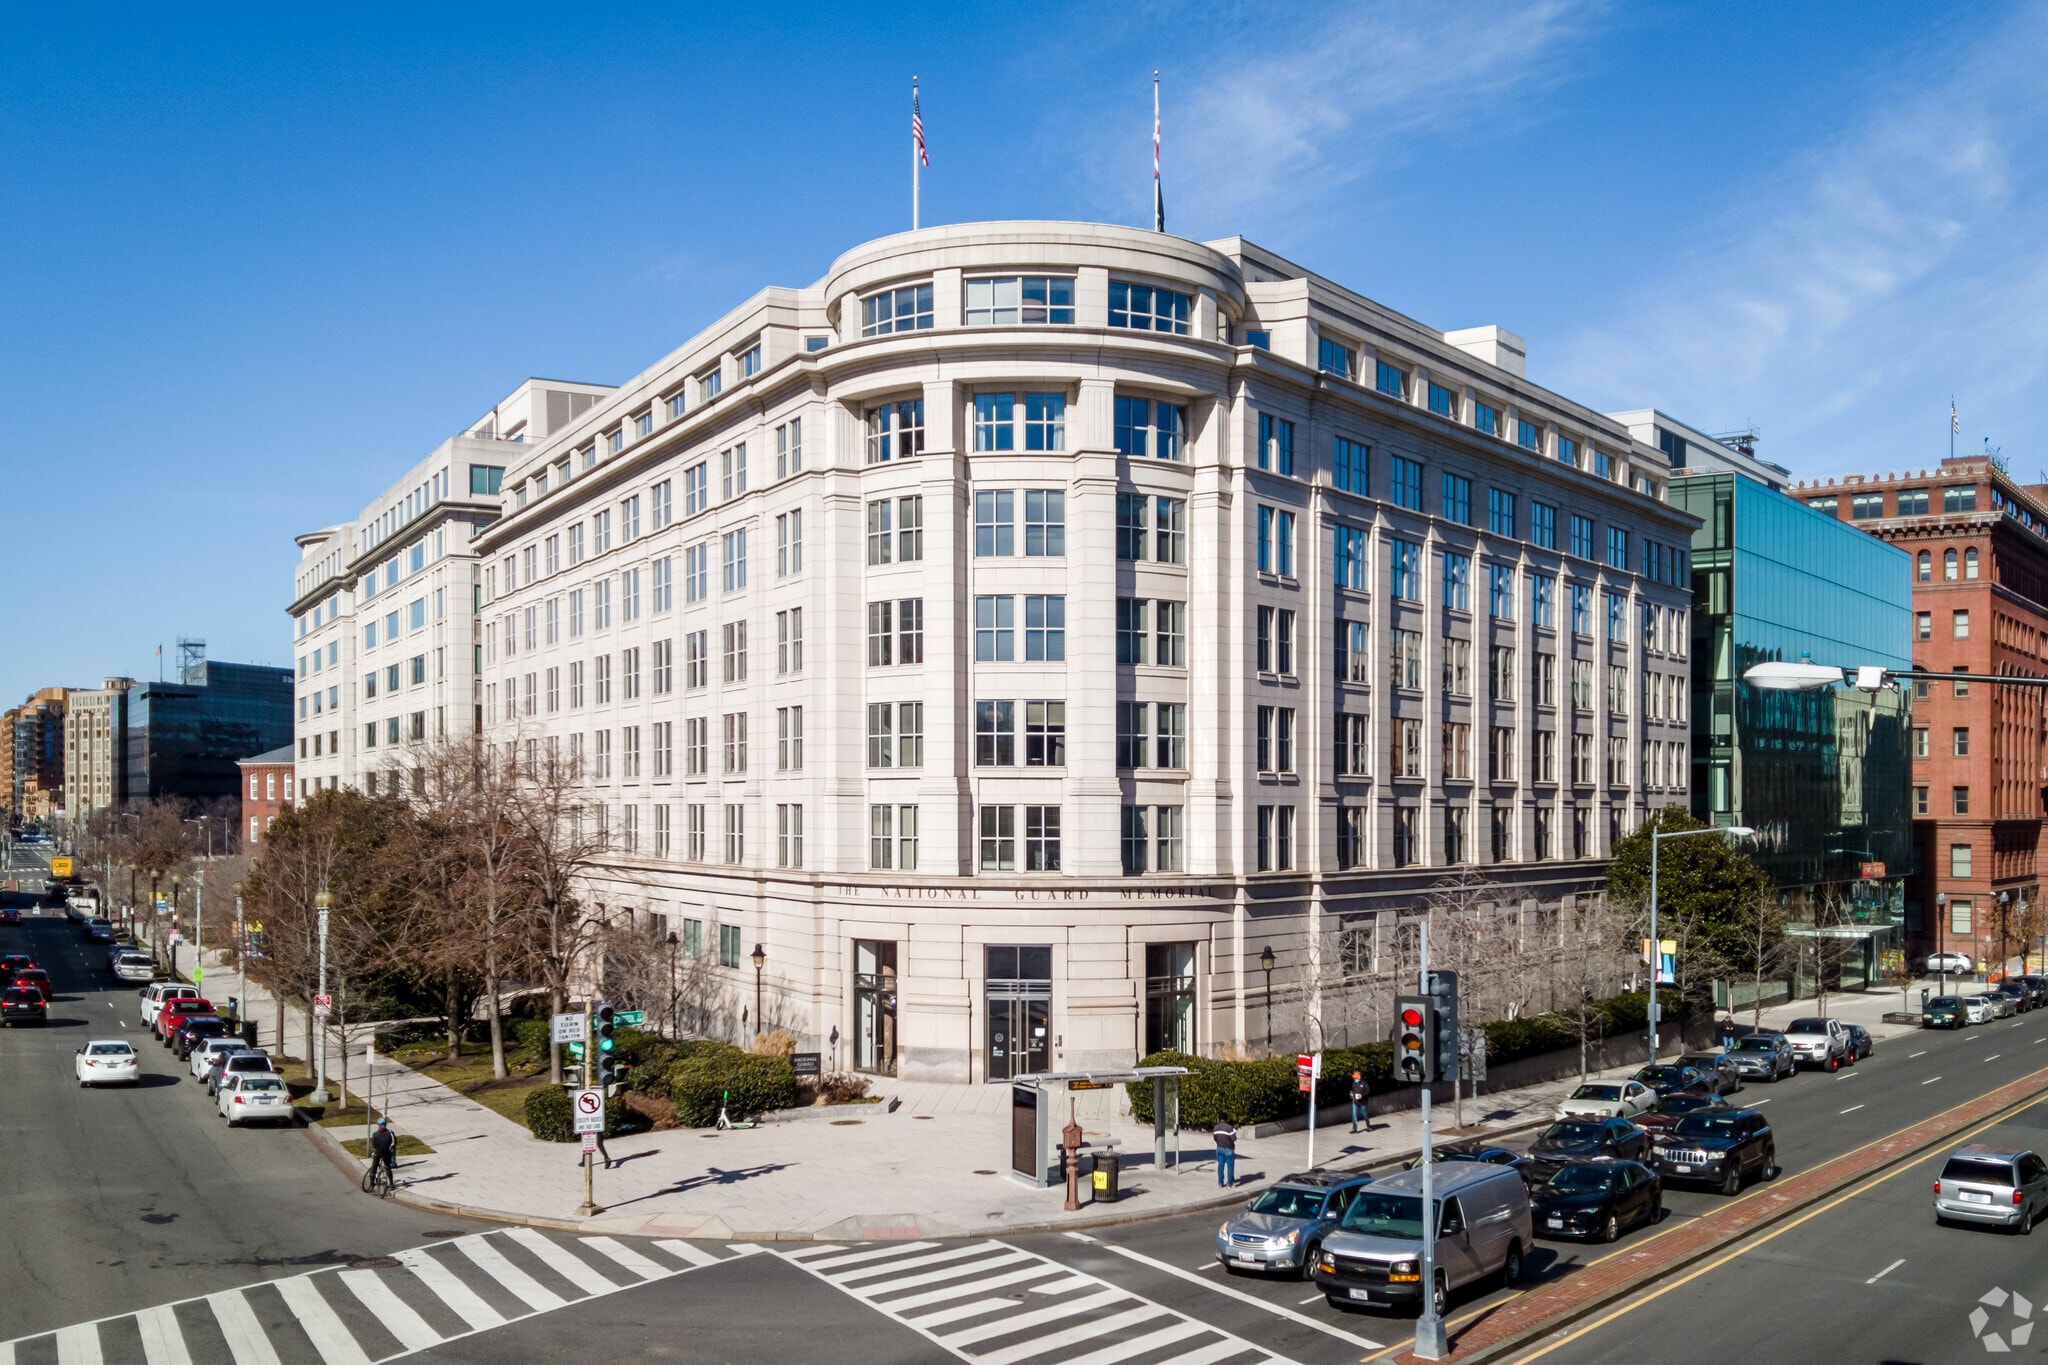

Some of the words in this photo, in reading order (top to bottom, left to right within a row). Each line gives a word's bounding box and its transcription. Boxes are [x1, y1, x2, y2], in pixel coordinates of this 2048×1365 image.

[839, 886, 860, 896] THE
[881, 888, 981, 900] NATIONAL
[1015, 889, 1089, 900] GUARD
[1120, 887, 1215, 900] MEMORIAL
